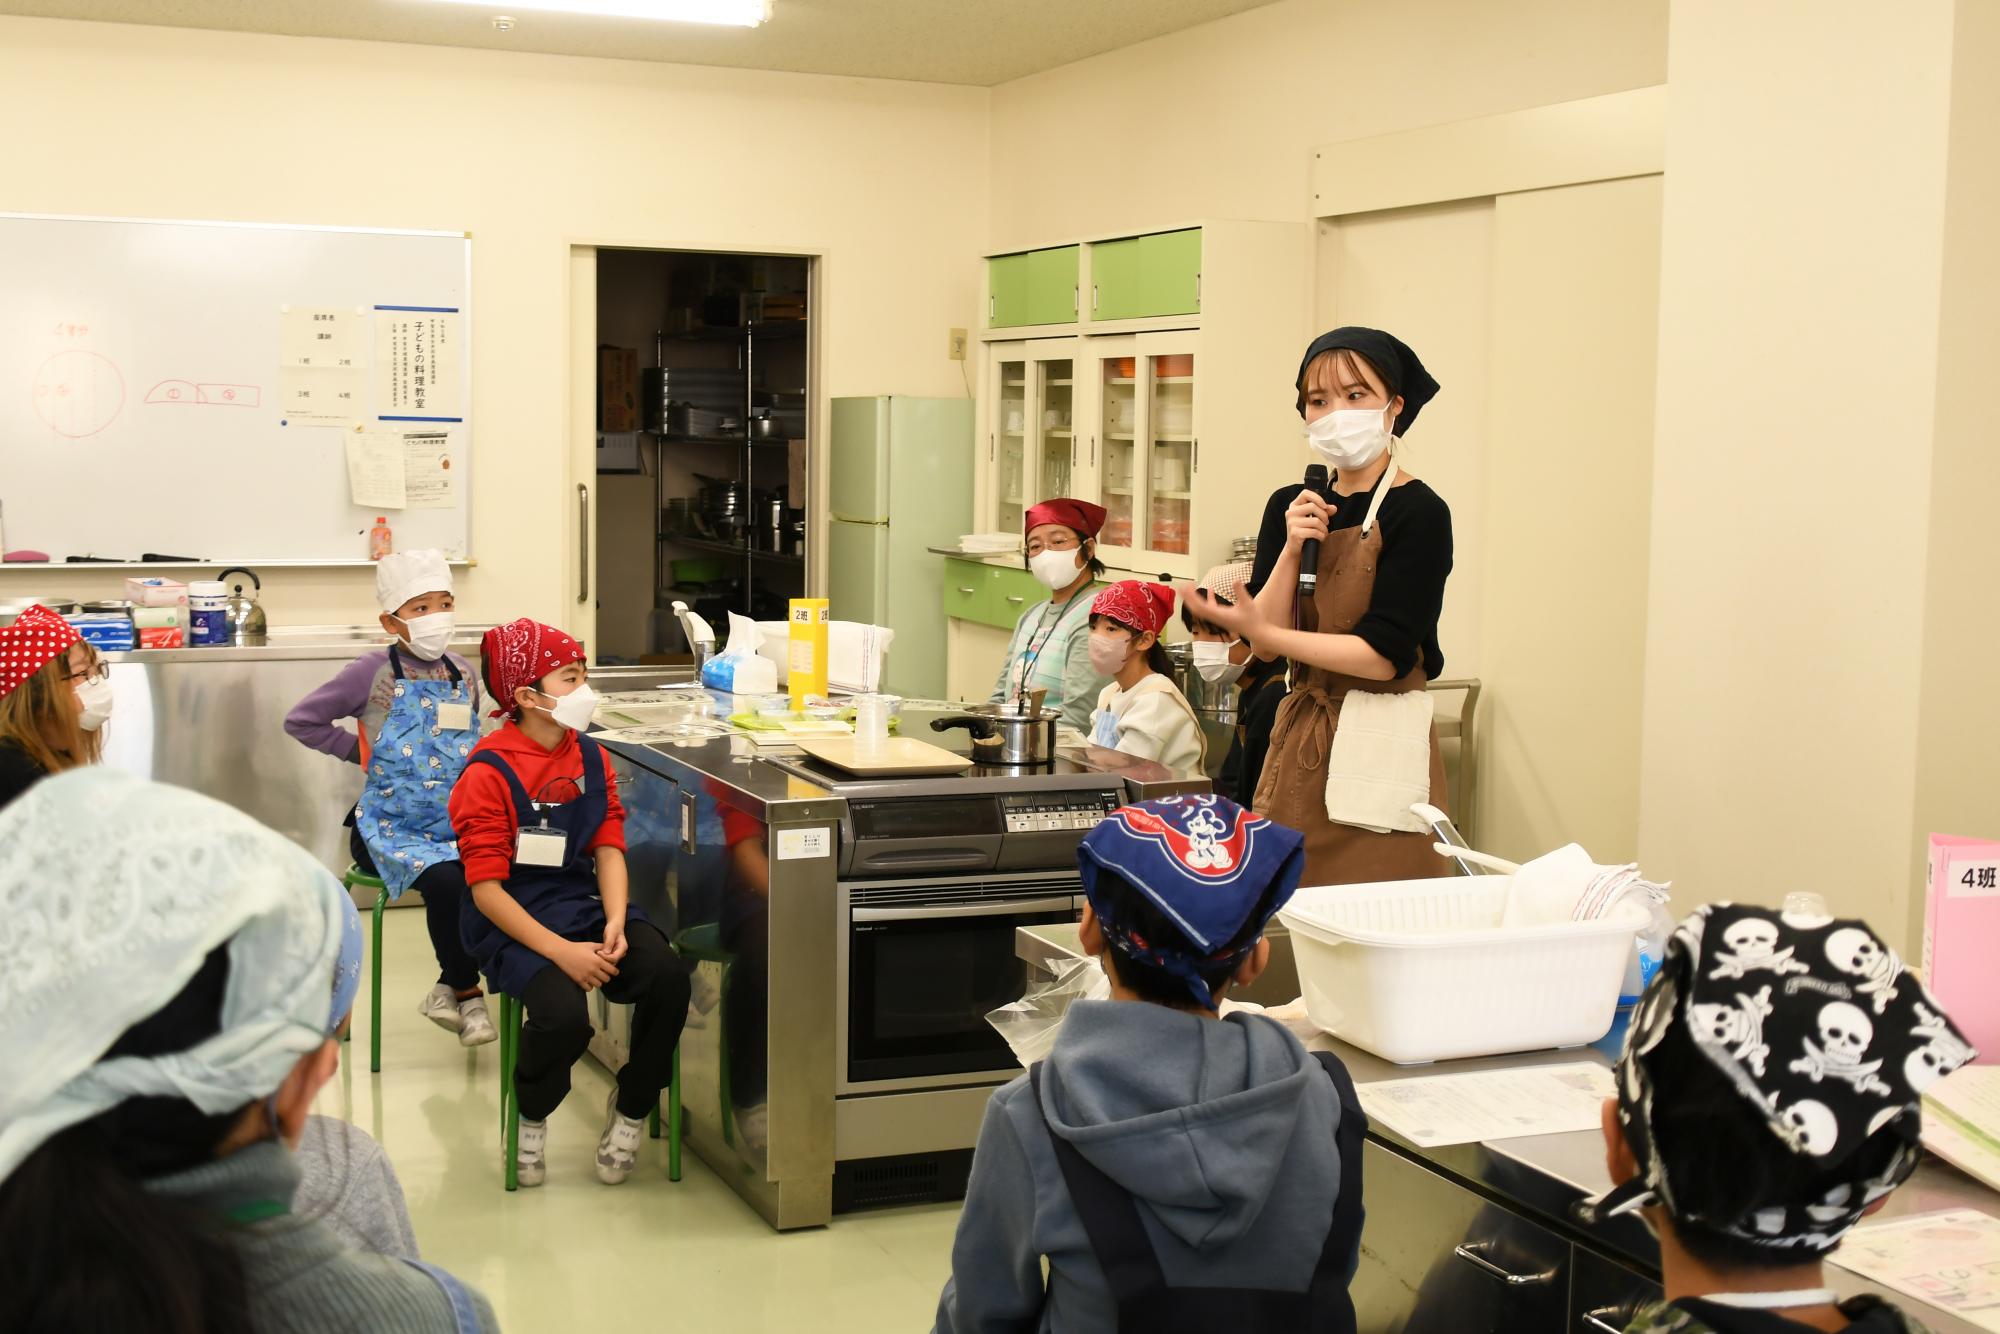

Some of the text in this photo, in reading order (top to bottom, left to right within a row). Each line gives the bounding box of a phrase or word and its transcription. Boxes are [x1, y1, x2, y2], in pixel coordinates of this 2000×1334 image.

[414, 321, 425, 409] 子どもの料理教室
[795, 610, 808, 621] 2班
[1961, 867, 1997, 888] 4班
